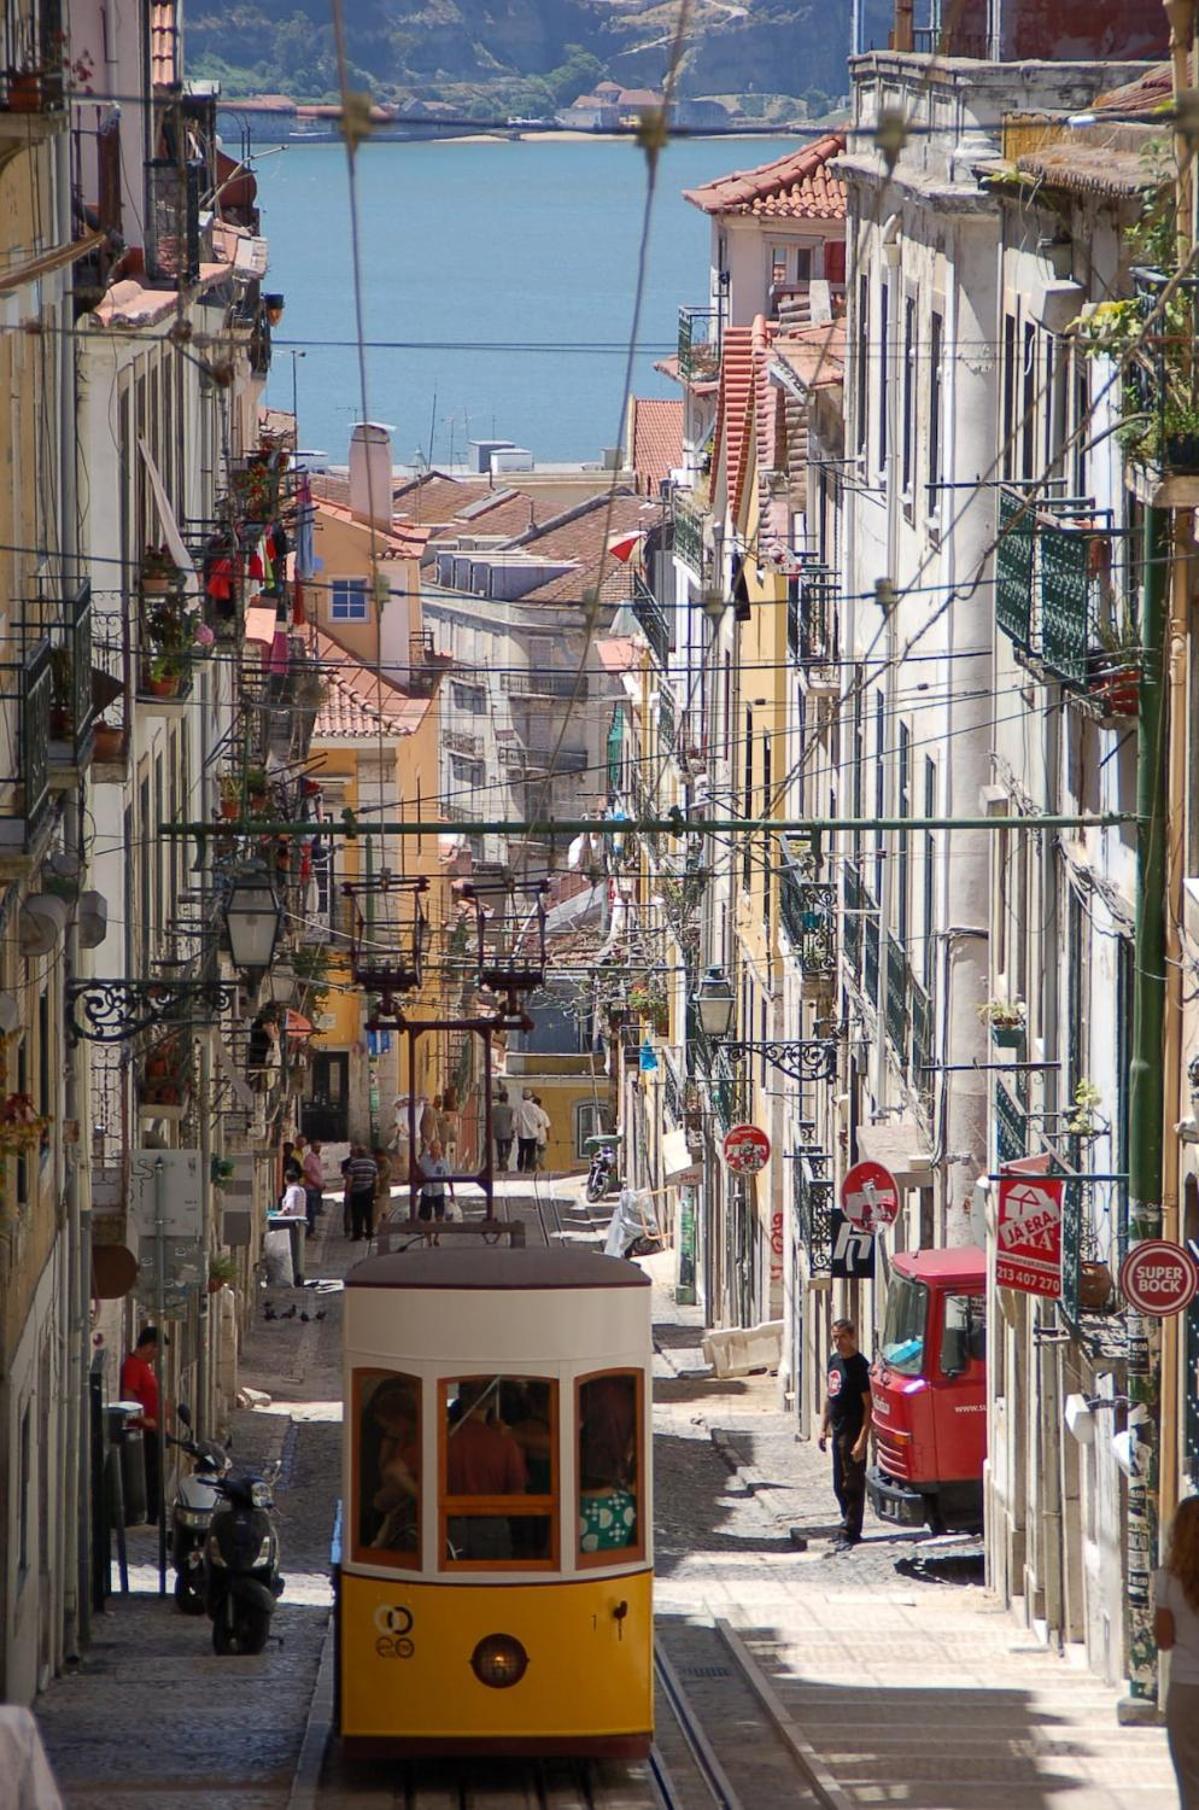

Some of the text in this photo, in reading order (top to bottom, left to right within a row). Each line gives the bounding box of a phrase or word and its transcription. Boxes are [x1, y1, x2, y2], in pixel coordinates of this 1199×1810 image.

[1008, 1221, 1024, 1244] JÁ
[997, 1265, 1060, 1293] 213 407 270
[1136, 1266, 1183, 1279] SUPER
[1139, 1280, 1180, 1292] BOCK
